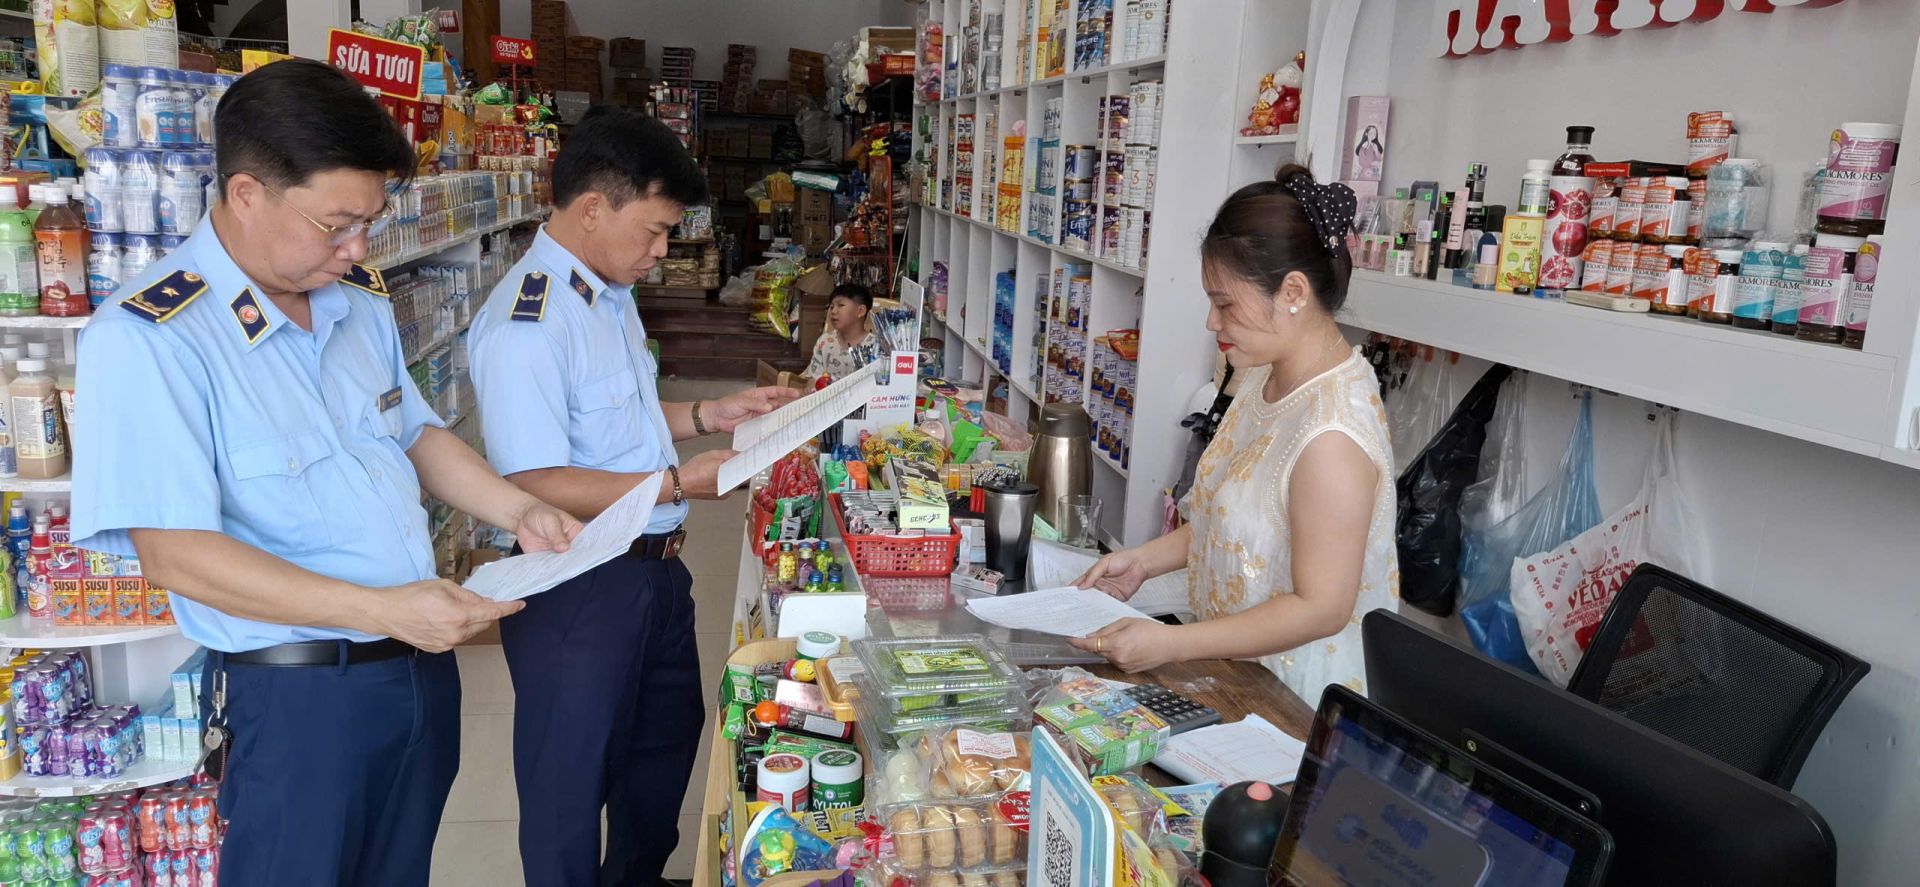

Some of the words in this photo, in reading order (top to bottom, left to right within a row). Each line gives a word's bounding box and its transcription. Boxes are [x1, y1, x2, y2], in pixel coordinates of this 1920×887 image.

[496, 40, 519, 53] Oishi
[336, 43, 370, 75] SỮA
[375, 53, 414, 84] TƯƠI
[1132, 169, 1140, 185] 3
[1147, 174, 1154, 189] 3
[53, 580, 77, 591] SUSU
[85, 580, 108, 591] SUSU
[116, 580, 139, 591] SUSU
